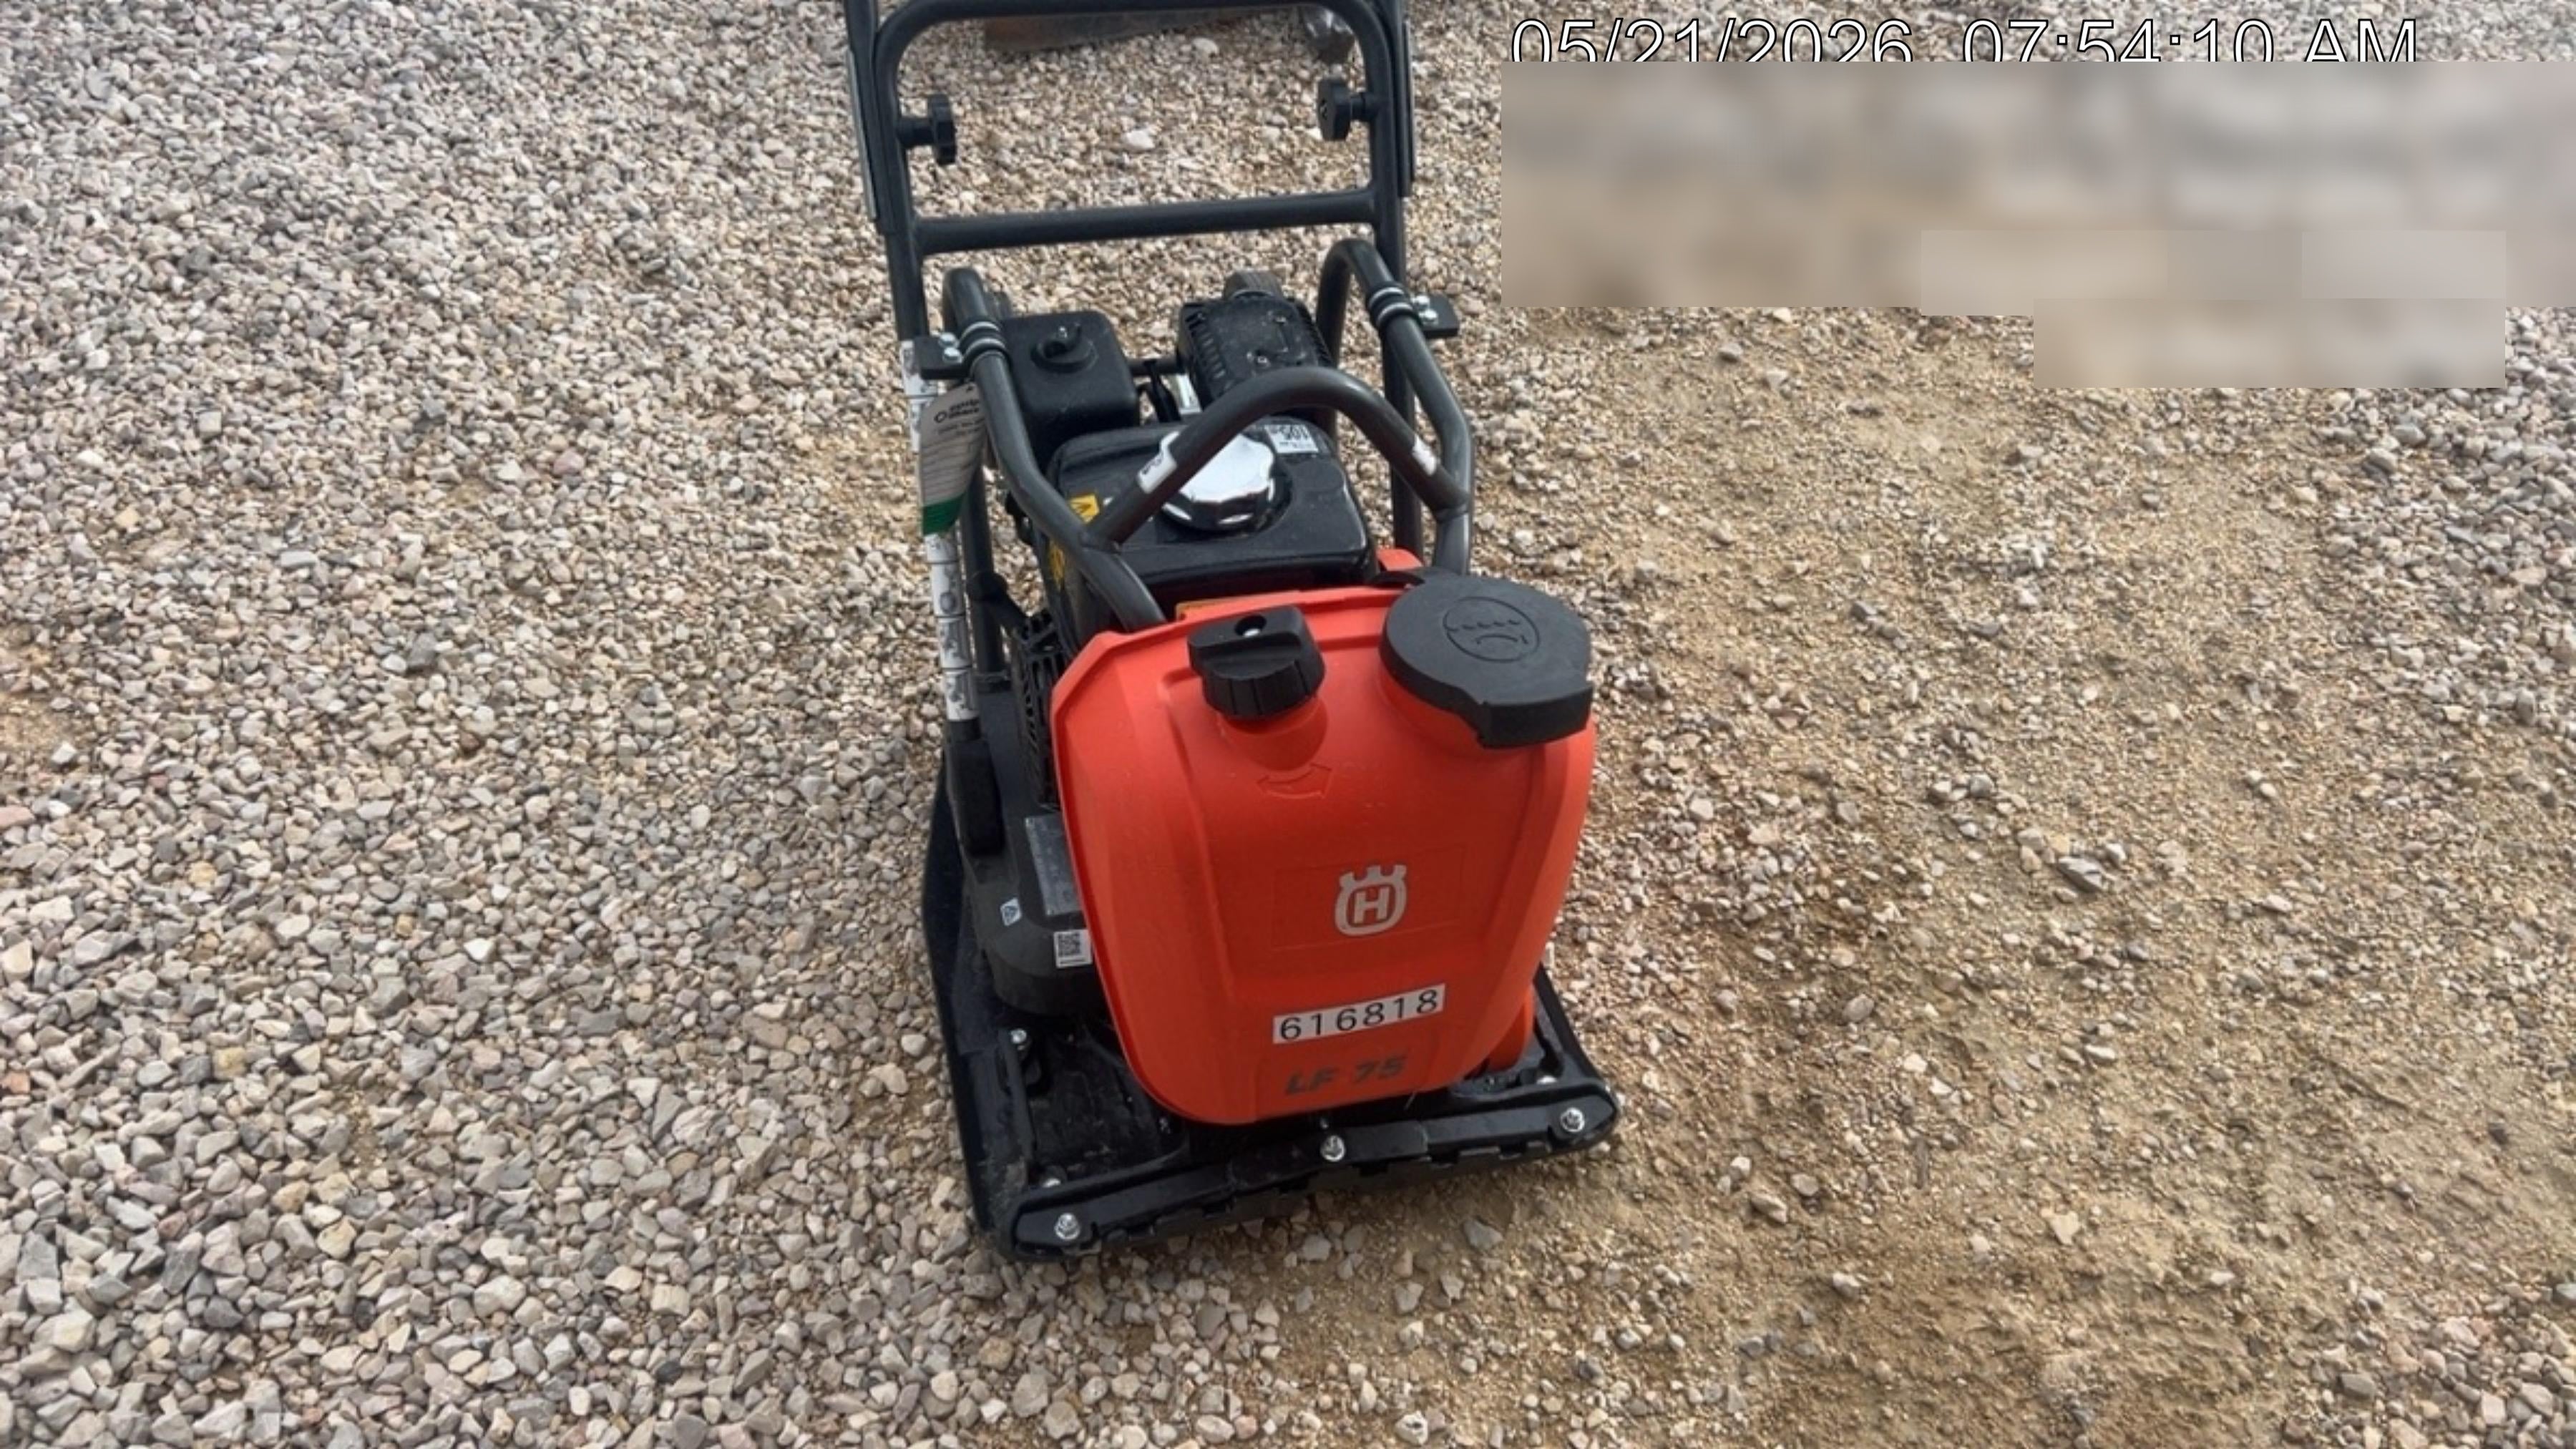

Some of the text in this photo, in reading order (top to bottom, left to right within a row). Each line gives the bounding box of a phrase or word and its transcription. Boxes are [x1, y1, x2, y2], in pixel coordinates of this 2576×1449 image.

[1279, 989, 1438, 1040] 616818
[1284, 1054, 1407, 1096] LF 75
